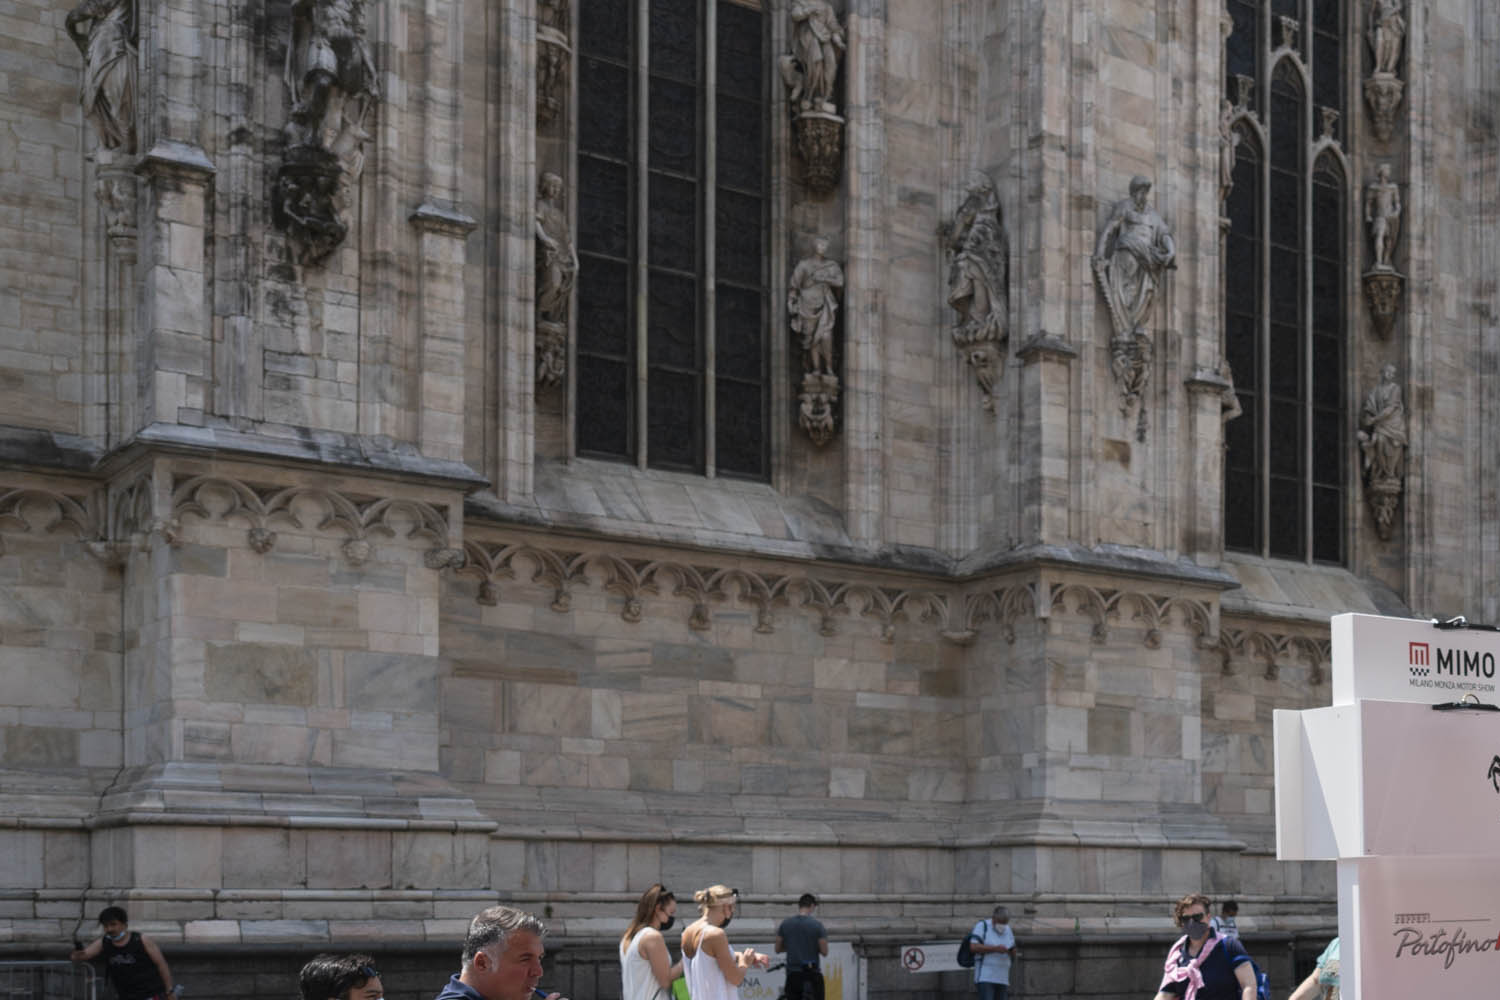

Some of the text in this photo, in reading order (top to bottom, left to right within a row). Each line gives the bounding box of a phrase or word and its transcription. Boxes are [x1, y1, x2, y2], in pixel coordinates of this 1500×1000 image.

[1437, 648, 1495, 678] MIMO
[1409, 678, 1433, 688] MILANO
[1434, 680, 1455, 690] MONZA
[1478, 683, 1496, 692] SHOW
